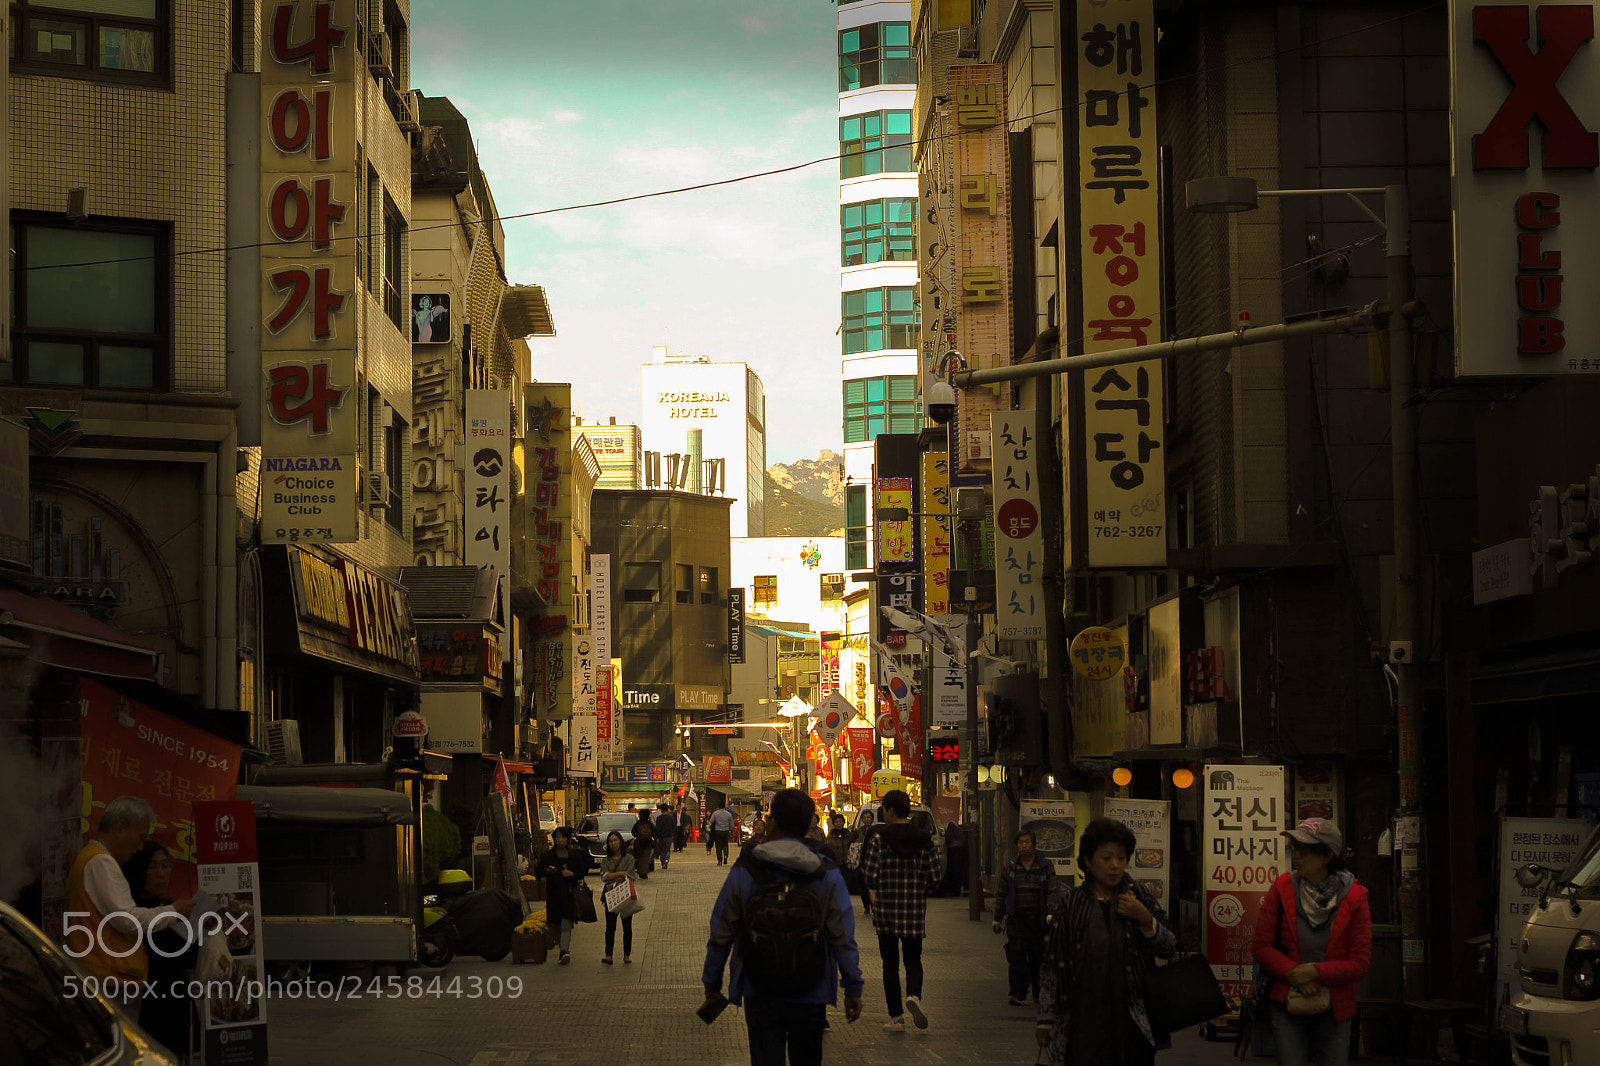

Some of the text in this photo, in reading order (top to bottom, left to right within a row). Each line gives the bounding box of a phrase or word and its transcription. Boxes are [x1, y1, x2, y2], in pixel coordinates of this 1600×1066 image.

[1472, 4, 1598, 170] X
[268, 4, 345, 434] 나이아가라
[1081, 20, 1160, 490] 해마루 정육 식당
[1516, 192, 1567, 354] CLUB
[658, 391, 729, 402] KOREANA
[669, 407, 718, 418] HOTEL
[1000, 422, 1033, 492] 참치
[265, 458, 343, 472] NIAGARA
[285, 477, 335, 489] Choice
[274, 493, 336, 504] Business
[287, 505, 322, 515] Club
[1093, 509, 1121, 522] 예약
[1094, 526, 1163, 538] 762-3267
[1004, 546, 1037, 616] 참치
[596, 572, 605, 660] HOTEL FIRST STAY
[731, 594, 740, 651] PLAY Time
[1002, 626, 1042, 636] 757-3787
[886, 635, 905, 644] BAR
[1087, 665, 1112, 678] 24시
[624, 690, 660, 704] Time
[680, 690, 718, 704] PLAY Time
[137, 724, 229, 772] SINCE 1954
[1212, 797, 1277, 831] 전신
[1213, 837, 1278, 861] 마사지
[1511, 850, 1576, 863] 다 모시지 못하
[1212, 865, 1279, 887] 40,000
[1510, 903, 1519, 914] 더
[1220, 967, 1230, 978] 남
